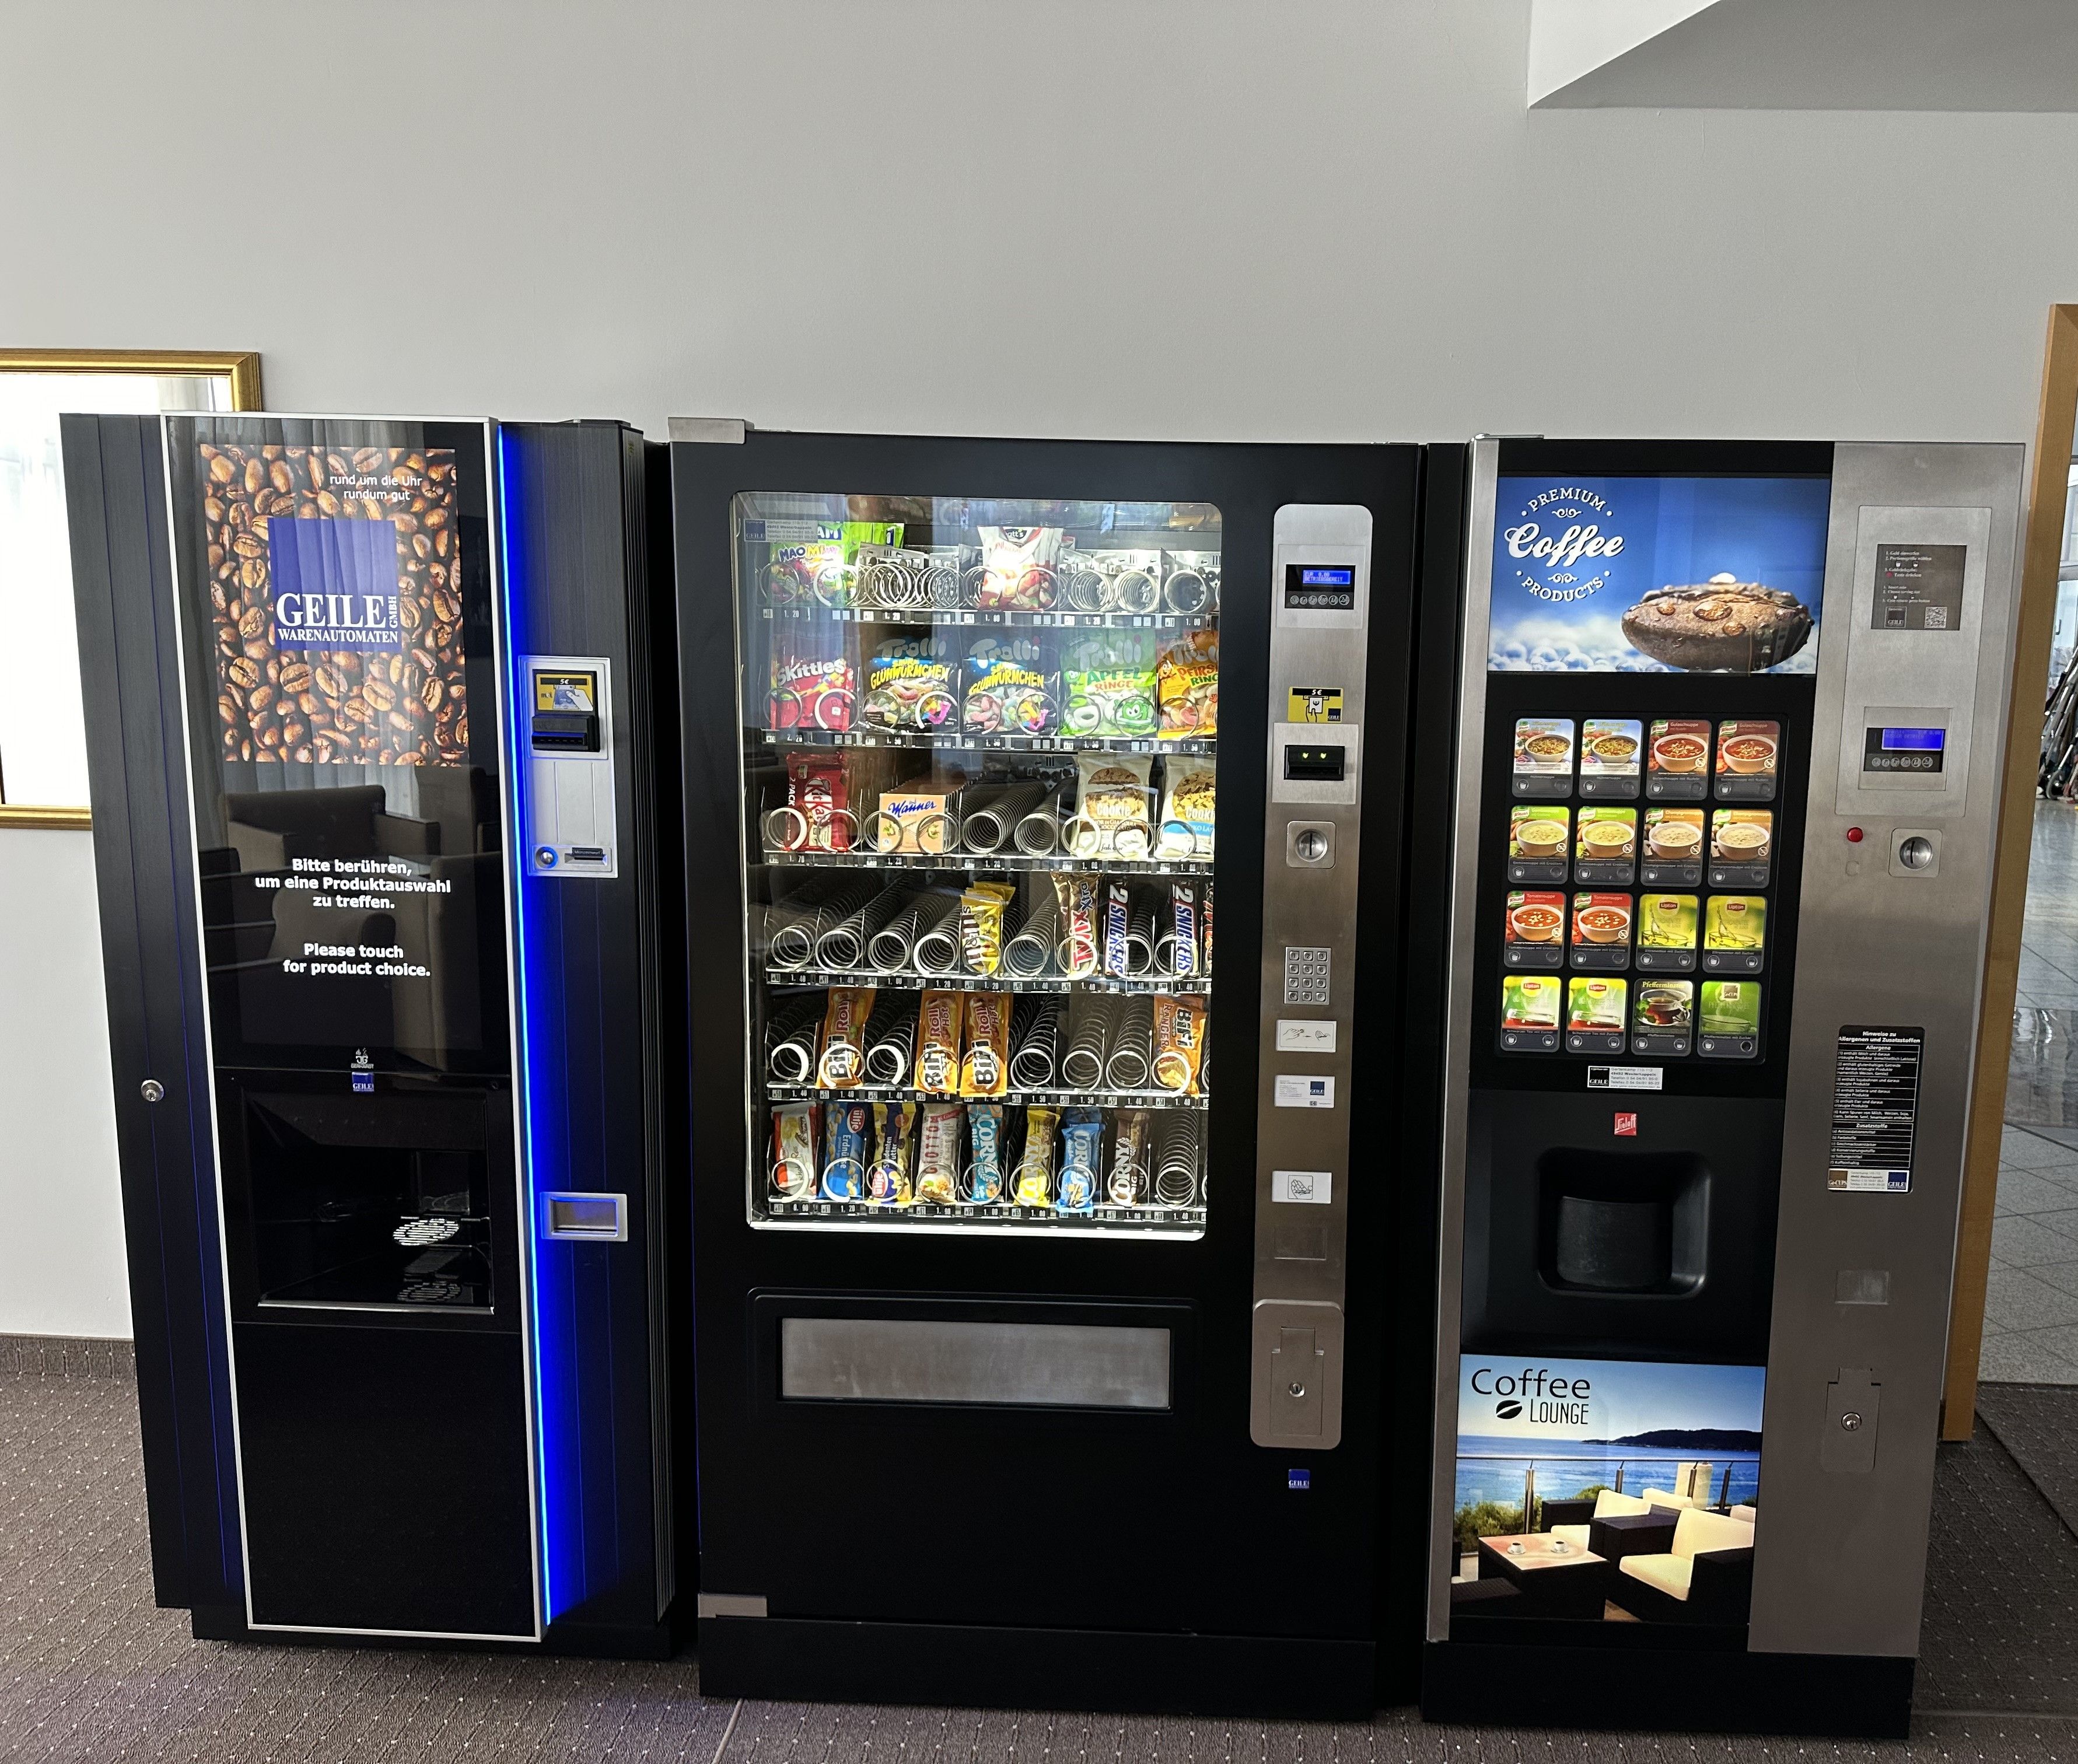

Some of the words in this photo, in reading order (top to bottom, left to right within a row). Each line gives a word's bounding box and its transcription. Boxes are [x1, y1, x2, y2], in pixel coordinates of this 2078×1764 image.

[330, 475, 355, 485] rund
[357, 477, 377, 485] um
[382, 475, 398, 486] die
[402, 476, 422, 487] Uhr
[344, 489, 387, 500] rundum
[391, 491, 410, 502] gut
[1528, 487, 1606, 512] PREMIUM
[1504, 523, 1624, 567] Coffee
[1521, 576, 1604, 601] PRODUCTS
[276, 592, 386, 628] GEILE
[389, 596, 398, 628] GMBH
[278, 628, 398, 643] WARENAUTOMATEN
[877, 634, 948, 662] Trolli
[970, 635, 1040, 669] Trolli
[1073, 634, 1142, 672] Trolli
[777, 658, 846, 686] Skittles
[870, 664, 950, 690] GLÜHWÜRMCHEN
[1087, 667, 1143, 684] APFEL
[888, 800, 937, 818] Manner
[292, 858, 330, 872] Bitte
[335, 860, 412, 876] berühren,
[255, 878, 280, 888] um
[285, 876, 319, 889] eine
[323, 879, 450, 892] Produktauswahl
[1110, 884, 1128, 904] 2
[1176, 886, 1194, 903] 2
[313, 897, 331, 907] zu
[336, 895, 395, 909] treffen.
[304, 943, 355, 957] Please
[359, 944, 403, 958] touch
[1109, 905, 1126, 974] SNICKERS
[1176, 905, 1193, 971] SNICKERS
[284, 960, 306, 972] for
[311, 962, 372, 975] product
[376, 963, 431, 977] choice.
[835, 1001, 849, 1031] Roll
[928, 1008, 942, 1037] Roll
[941, 1006, 950, 1027] Hot
[975, 1007, 992, 1035] Roll
[988, 1003, 999, 1024] Hot
[1160, 1004, 1174, 1047] RANGER
[851, 1110, 863, 1130] ültje
[840, 1135, 852, 1169] Erdnüse
[888, 1143, 898, 1163] utter
[1111, 1143, 1132, 1207] CORNY
[1471, 1368, 1590, 1399] Coffee
[1530, 1399, 1589, 1424] LOUNGE
